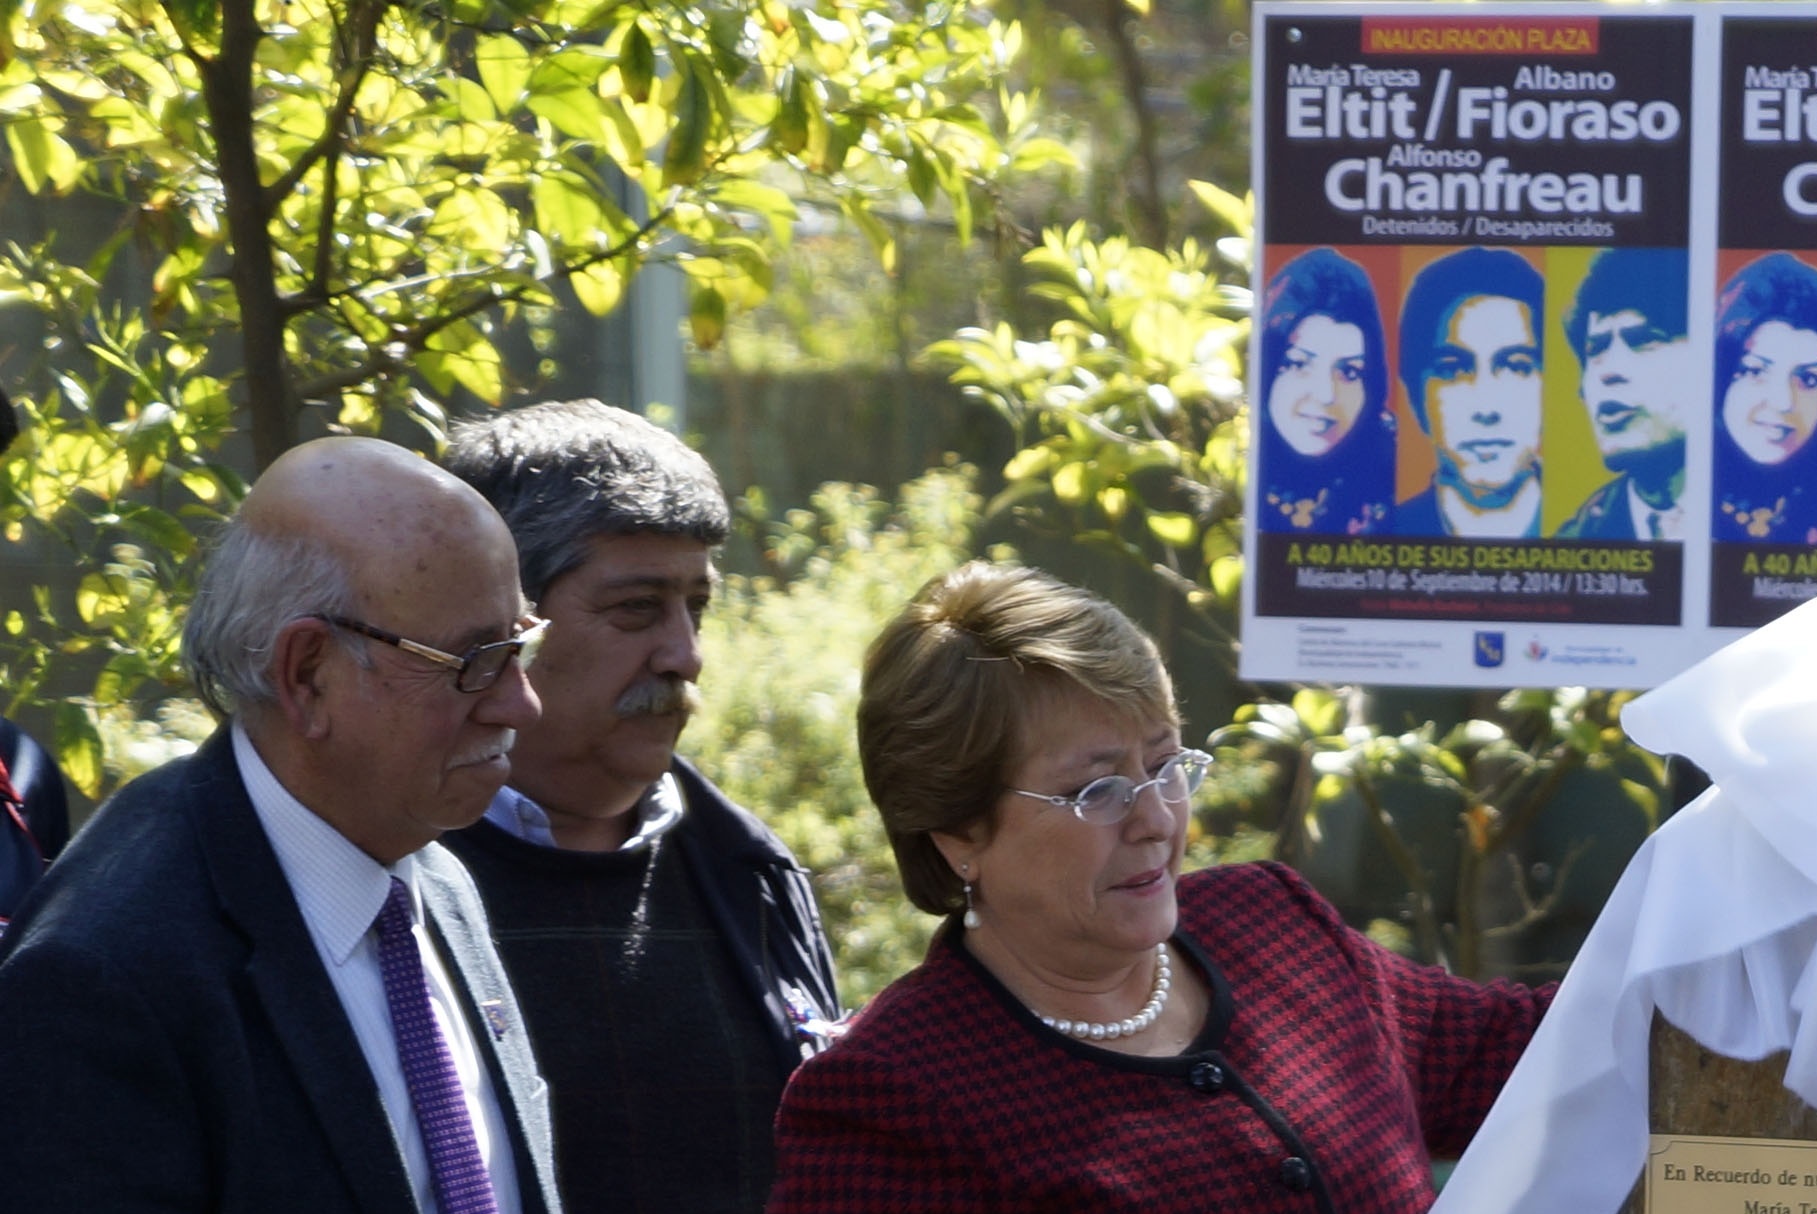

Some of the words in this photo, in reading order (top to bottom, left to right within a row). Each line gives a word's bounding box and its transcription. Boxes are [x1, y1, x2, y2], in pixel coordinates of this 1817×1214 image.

[1371, 26, 1522, 51] INAUGURACIÓN
[1528, 29, 1591, 51] PLAZA
[1288, 64, 1349, 87] María
[1352, 65, 1421, 87] Teresa
[1514, 66, 1615, 91] Albano
[1745, 66, 1808, 89] María
[1286, 86, 1416, 138] Eltit
[1458, 86, 1681, 141] Fioraso
[1387, 145, 1481, 168] Alfonso
[1324, 157, 1642, 212] Chanfreau
[1363, 216, 1458, 236] Detenidos
[1462, 217, 1471, 236] /
[1475, 217, 1614, 239] Desaparecidos
[1287, 542, 1302, 565] A
[1306, 544, 1332, 565] 40
[1335, 539, 1393, 567] AÑOS
[1398, 545, 1425, 567] DE
[1429, 546, 1470, 568] SUS
[1473, 546, 1653, 572] DESAPARICIONES
[1743, 552, 1759, 575] A
[1762, 554, 1790, 575] 40
[1388, 568, 1408, 591] de
[1410, 568, 1497, 595] Septiembre
[1500, 571, 1520, 592] de
[1521, 571, 1561, 593] 2014
[1663, 1164, 1687, 1182] En
[1693, 1166, 1772, 1186] Recuerdo
[1777, 1169, 1798, 1188] de
